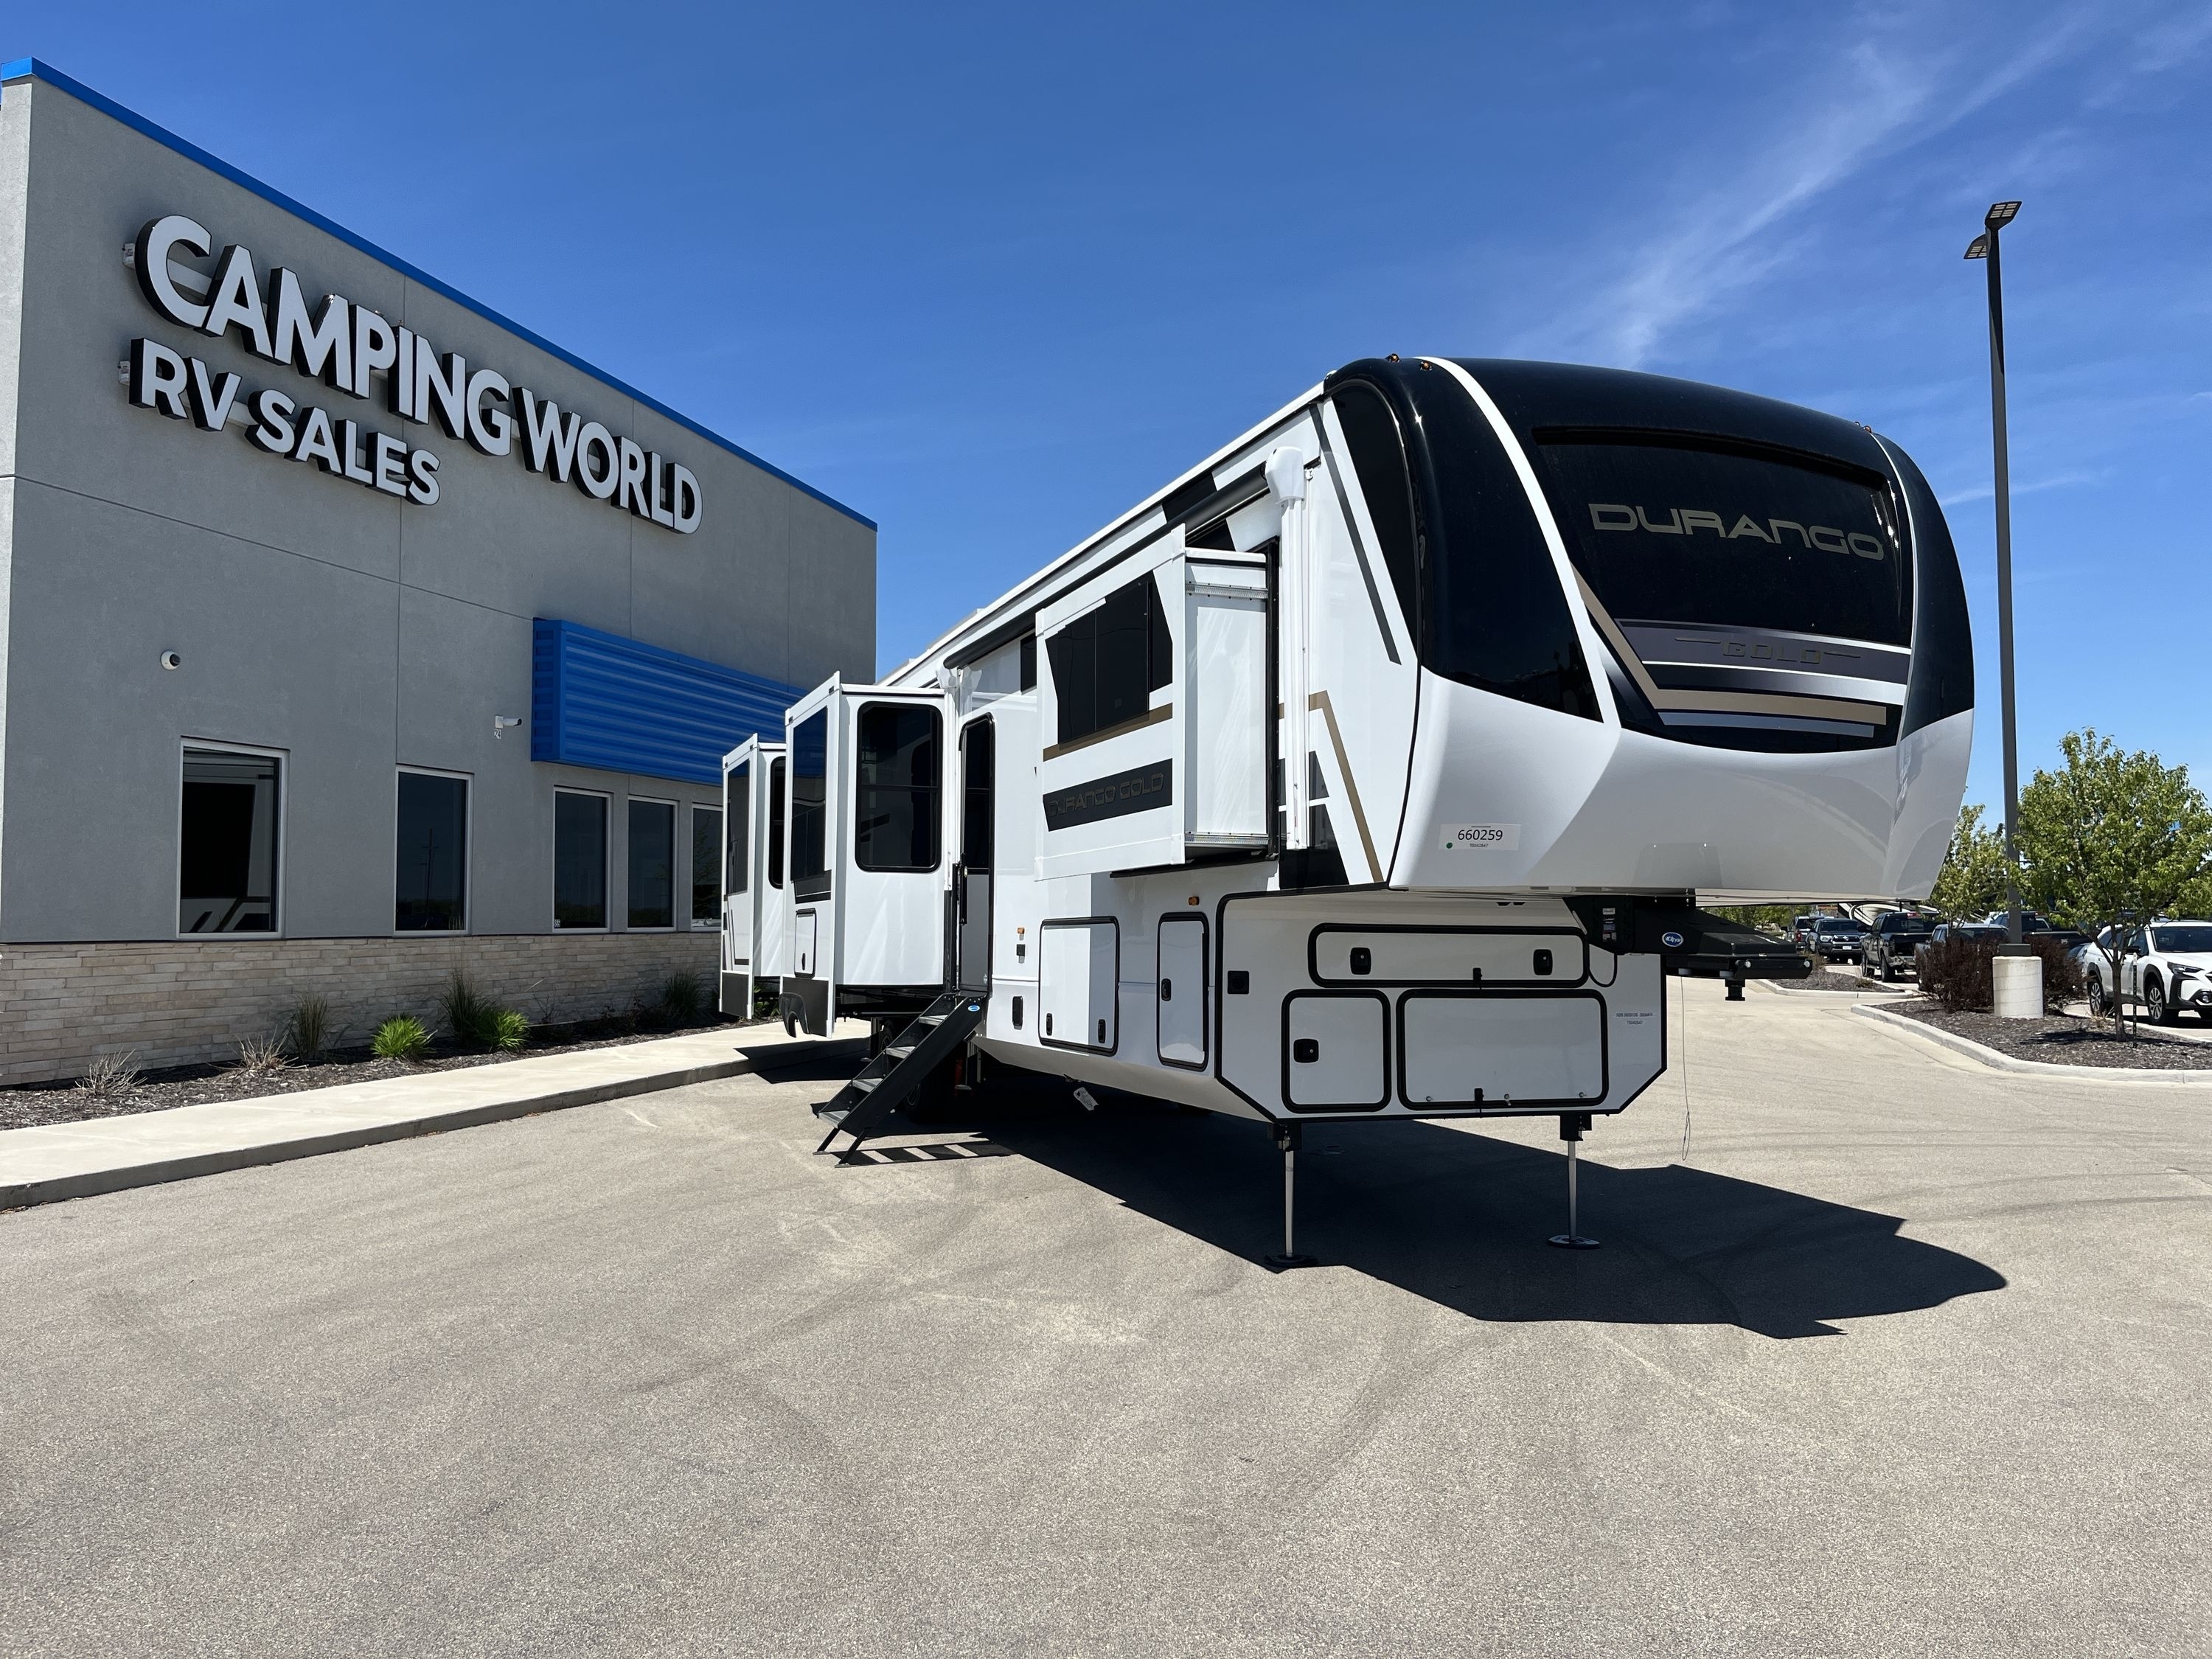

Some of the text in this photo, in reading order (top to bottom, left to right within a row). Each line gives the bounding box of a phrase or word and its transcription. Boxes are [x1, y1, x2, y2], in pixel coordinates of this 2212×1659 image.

[139, 215, 703, 535] CAMPING WORLD
[131, 338, 442, 506] RV SALES
[1588, 503, 1885, 561] DURANGO
[1722, 640, 1822, 664] GOLD
[1047, 772, 1164, 817] DURANGO GOLD
[1458, 830, 1503, 841] 660259
